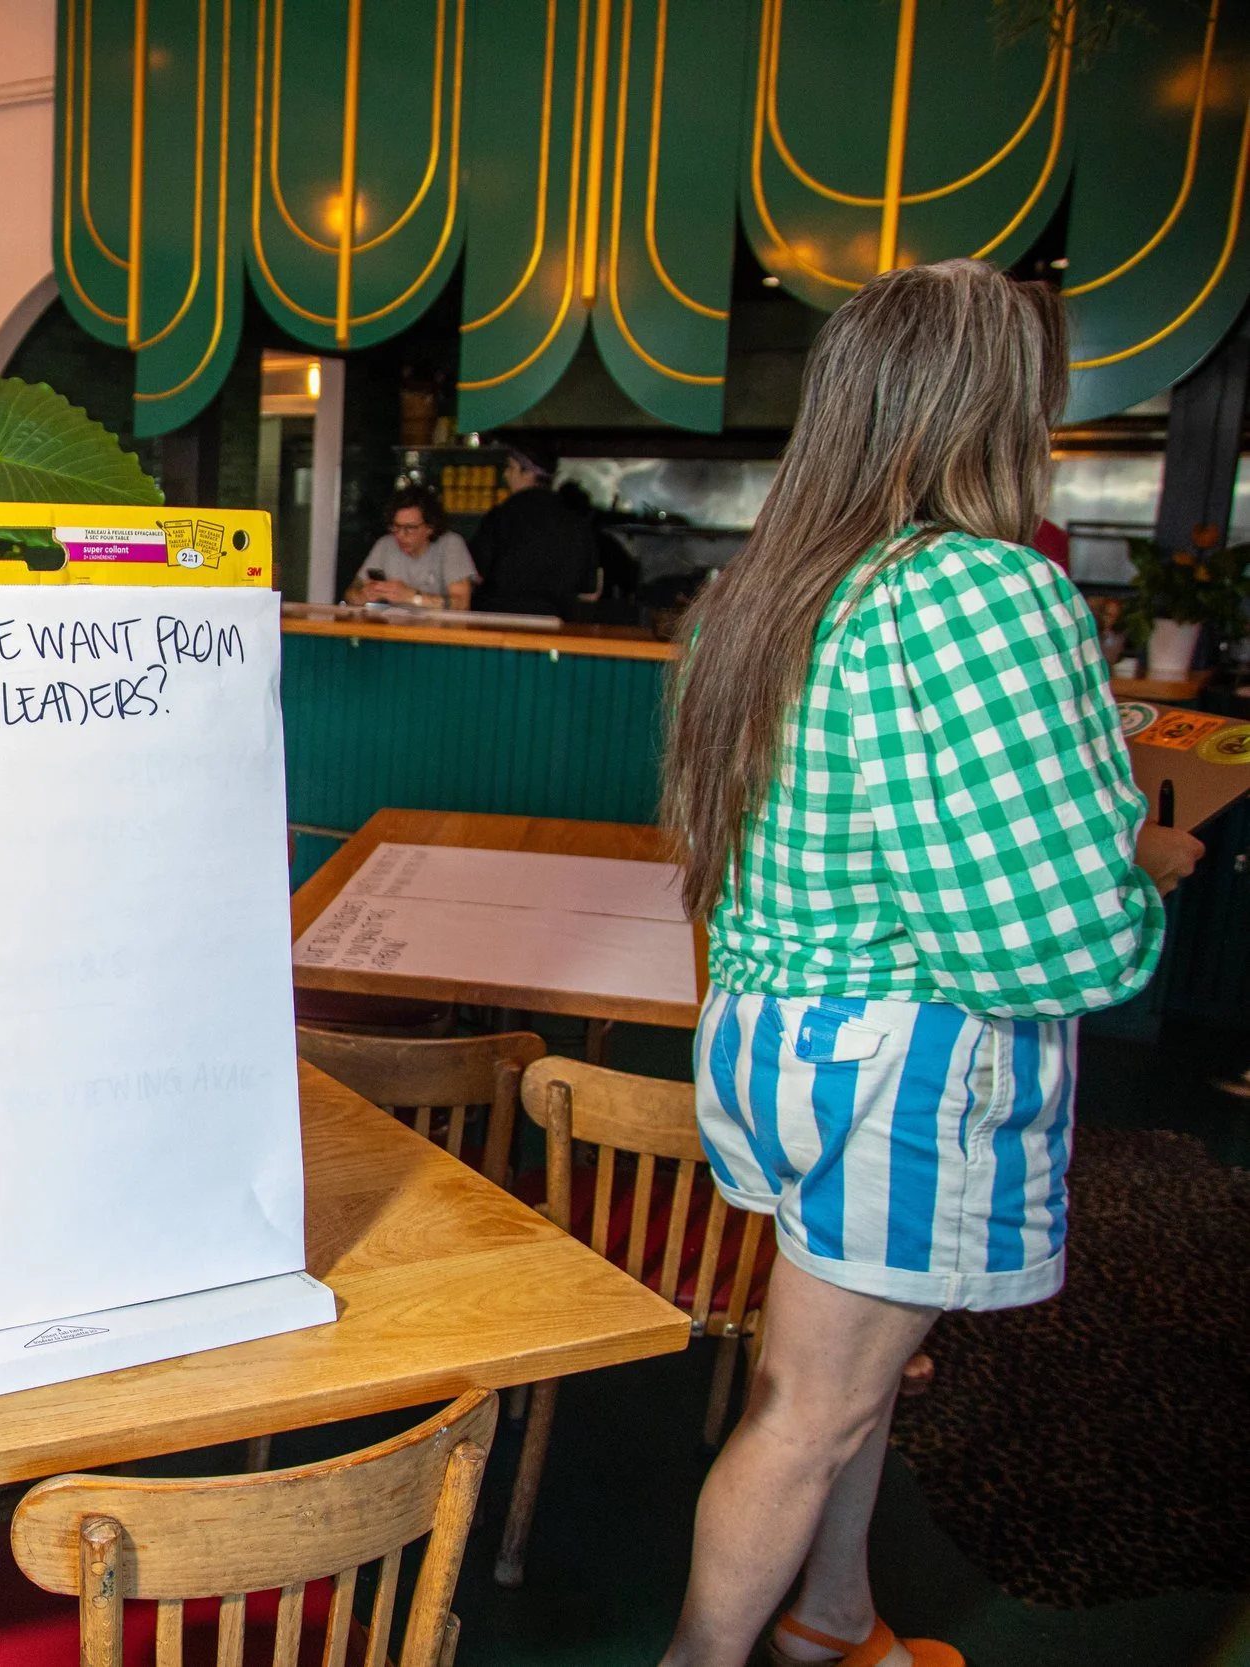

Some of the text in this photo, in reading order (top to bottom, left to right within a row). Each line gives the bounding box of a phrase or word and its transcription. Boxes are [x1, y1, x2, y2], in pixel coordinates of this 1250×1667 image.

[83, 545, 129, 554] super collant
[182, 553, 187, 562] 2
[247, 567, 262, 576] 3M
[27, 618, 142, 664] WANT
[156, 615, 245, 667] FROM
[2, 663, 170, 726] LEADERS?
